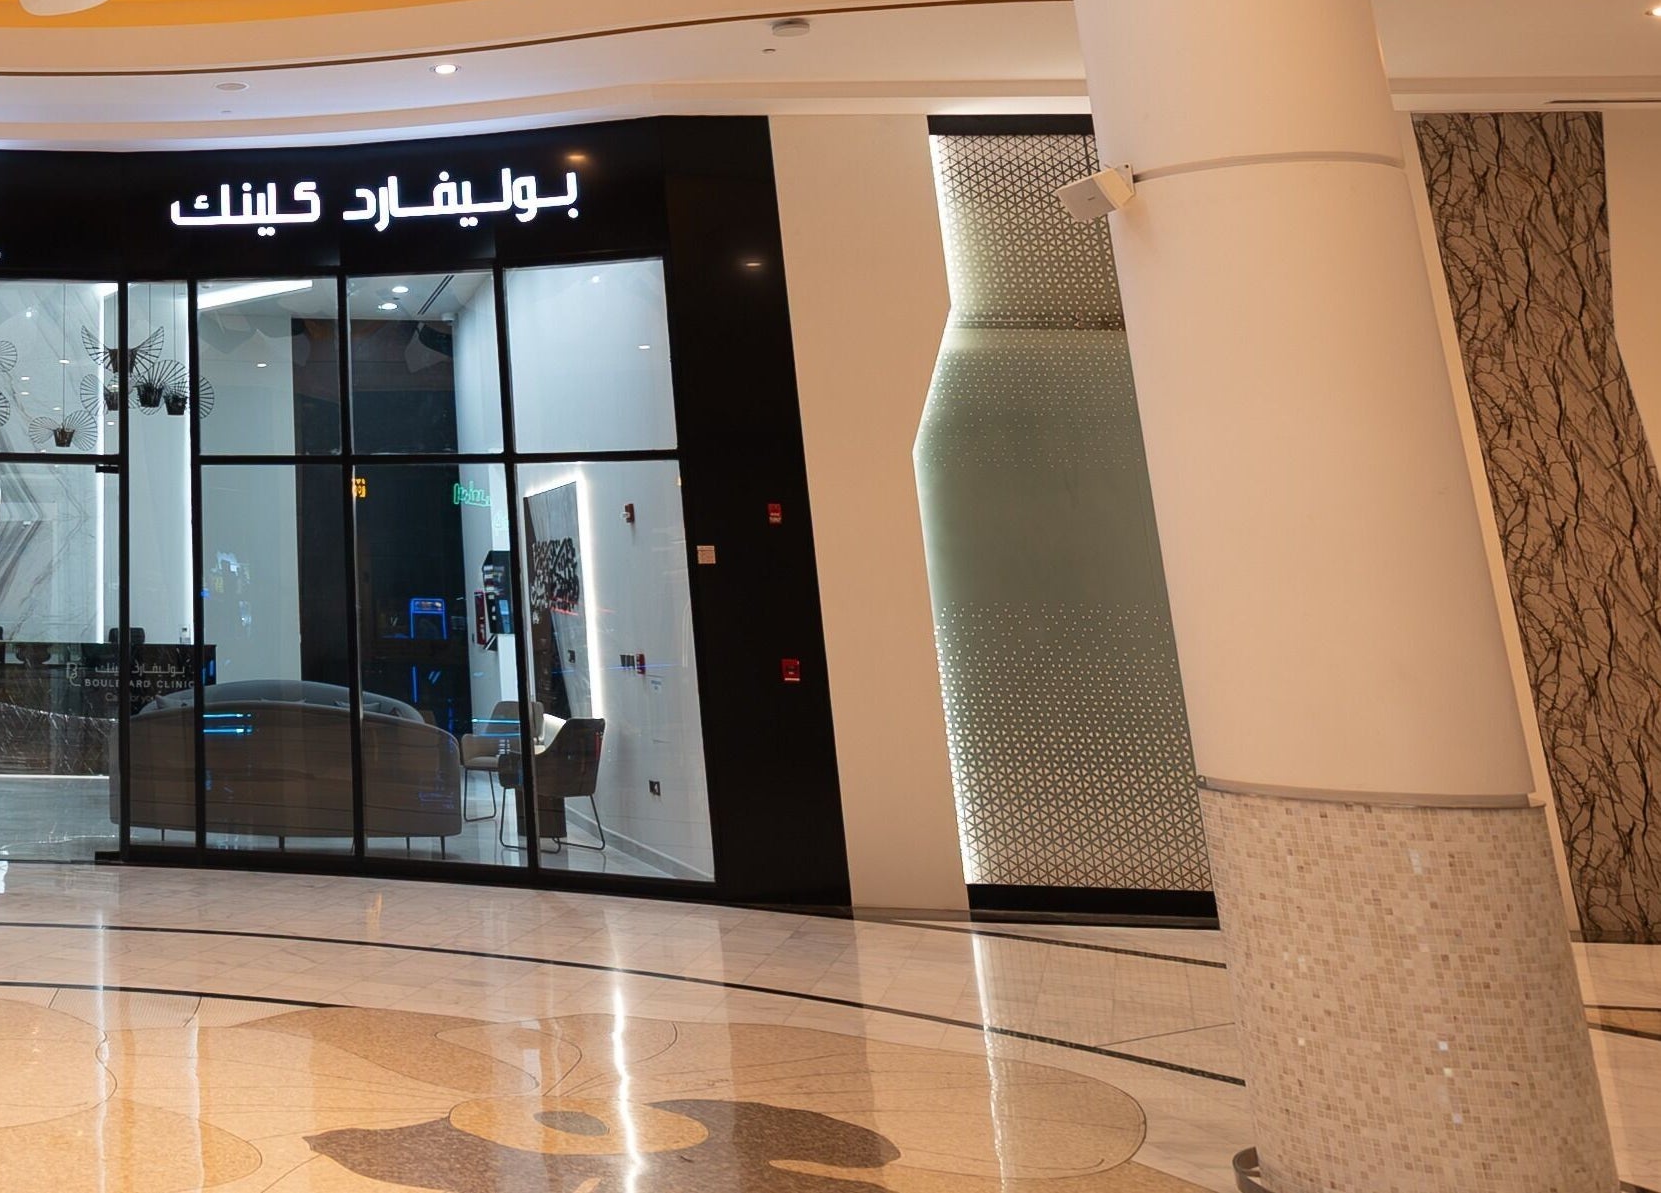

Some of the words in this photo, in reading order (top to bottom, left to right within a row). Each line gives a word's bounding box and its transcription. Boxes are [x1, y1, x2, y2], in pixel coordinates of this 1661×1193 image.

[170, 181, 321, 237] كلينك
[342, 167, 579, 232] بوليفارد
[84, 678, 152, 689] BOULEARD
